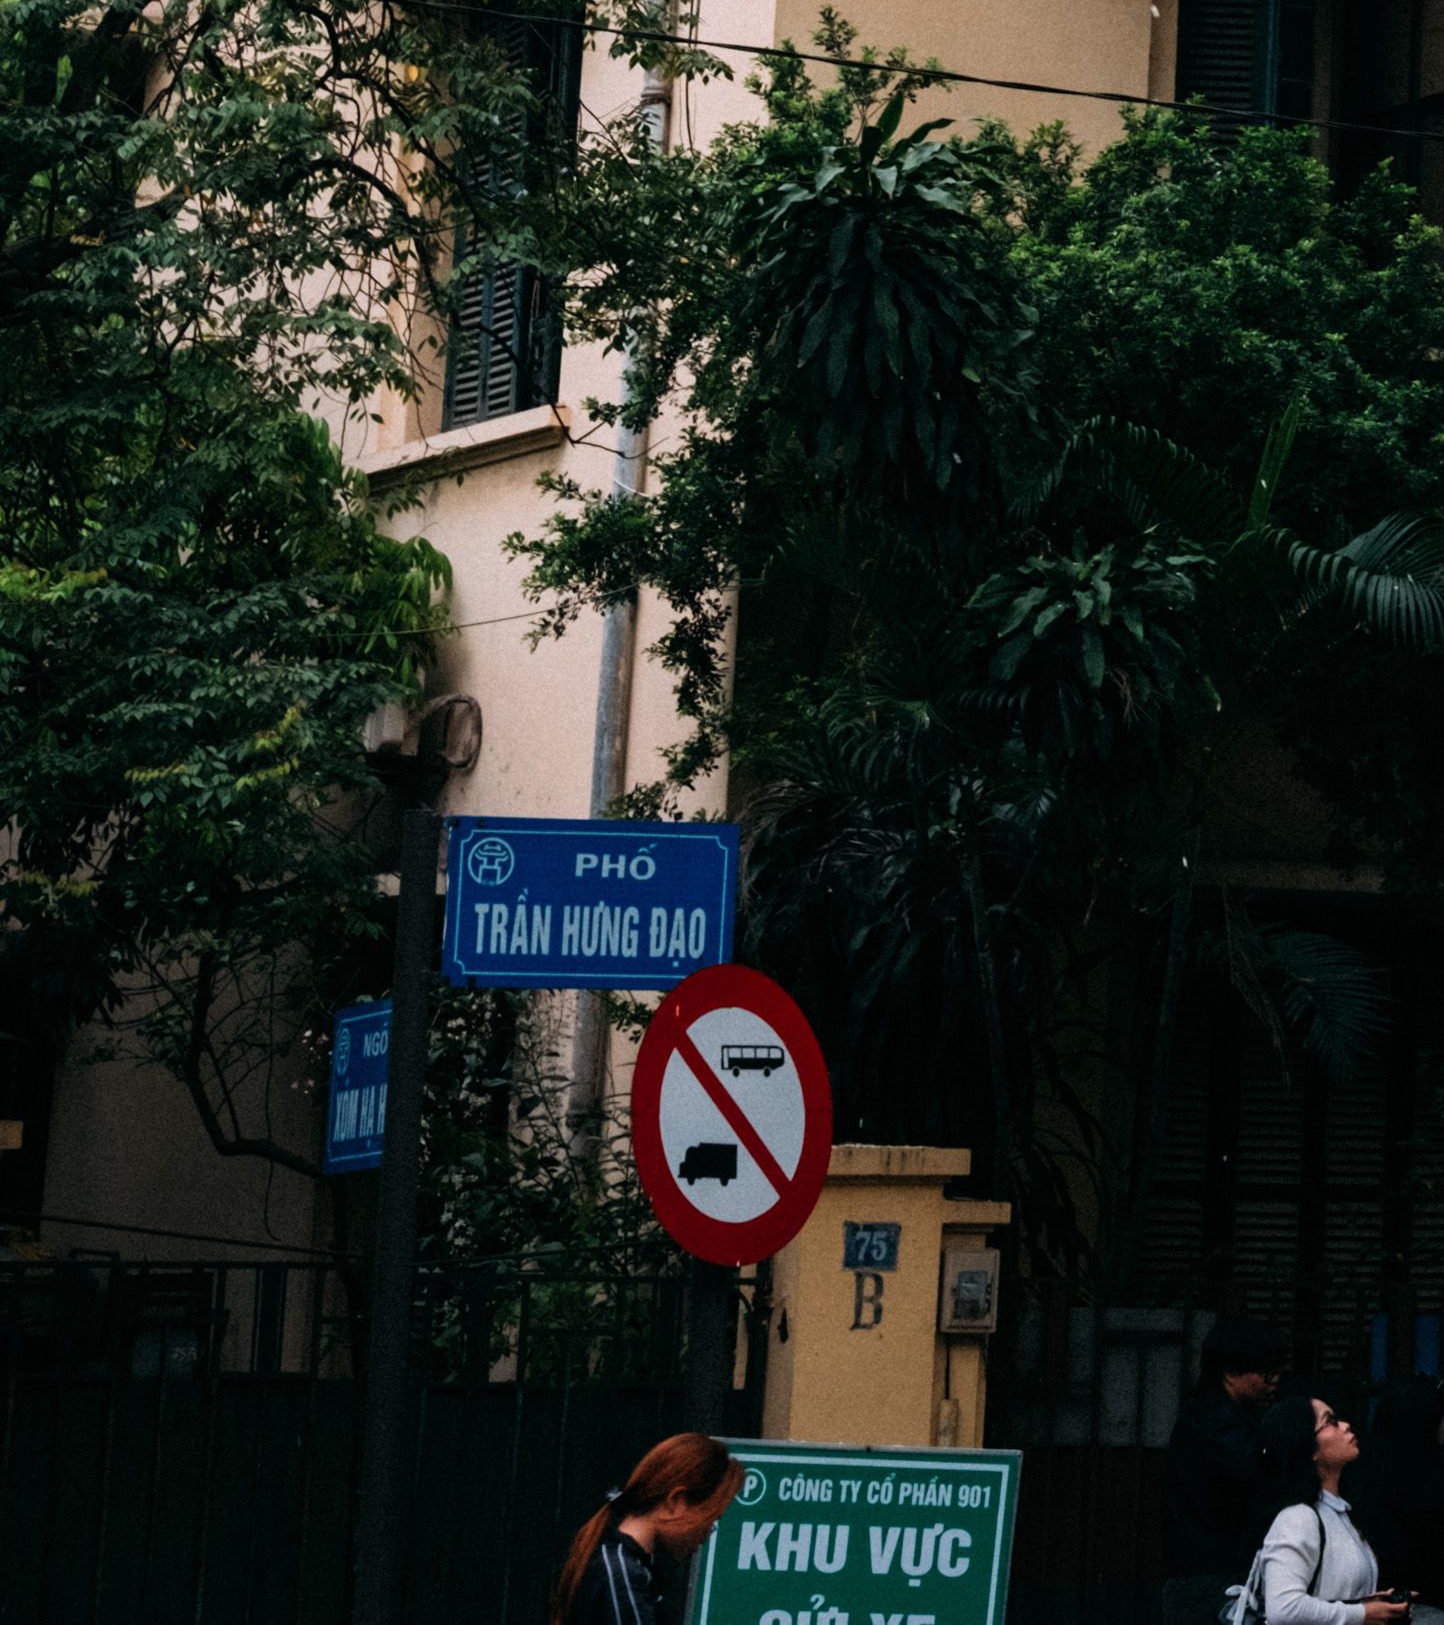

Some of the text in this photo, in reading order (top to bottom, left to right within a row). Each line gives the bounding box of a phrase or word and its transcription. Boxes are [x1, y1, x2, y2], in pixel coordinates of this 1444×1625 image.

[575, 843, 658, 880] PHỐ
[474, 887, 706, 967] TRẦN HƯNG ĐẠO
[855, 1231, 887, 1261] 75
[850, 1271, 884, 1330] B
[779, 1473, 833, 1503] CÔNG
[839, 1480, 862, 1504] TY
[867, 1472, 896, 1505] CỔ
[899, 1476, 952, 1508] PHẦN
[958, 1485, 991, 1509] 901
[737, 1521, 972, 1588] KHU VỰC
